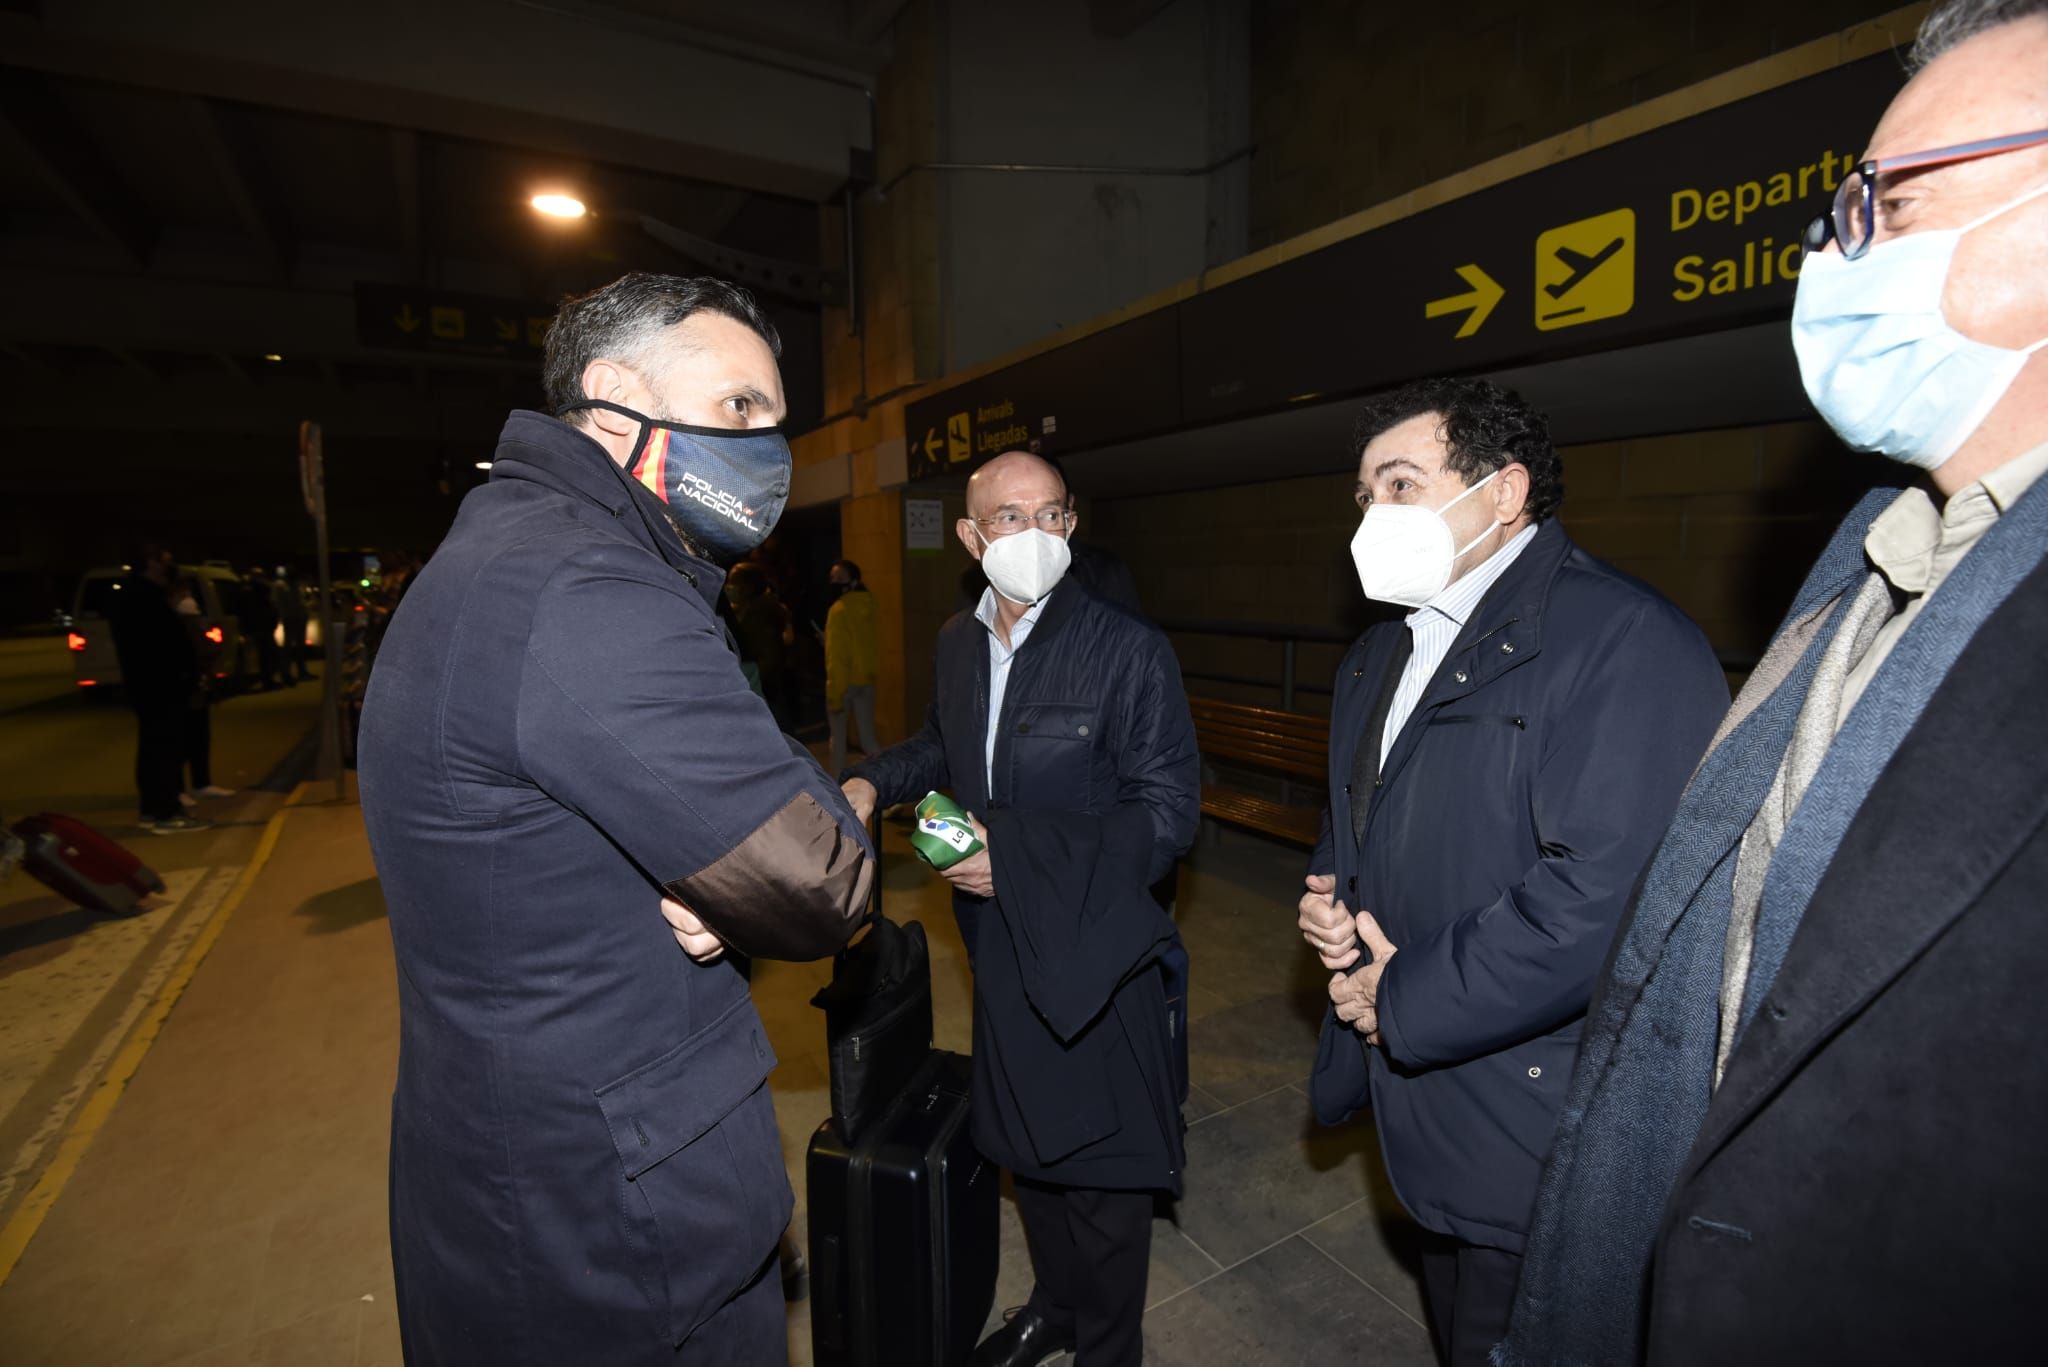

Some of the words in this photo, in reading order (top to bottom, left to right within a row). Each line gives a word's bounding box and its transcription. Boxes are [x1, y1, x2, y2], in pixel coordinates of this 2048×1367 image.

[976, 424, 1028, 453] Llegadas
[677, 483, 758, 531] NACIONAL
[682, 472, 743, 512] POLICIA
